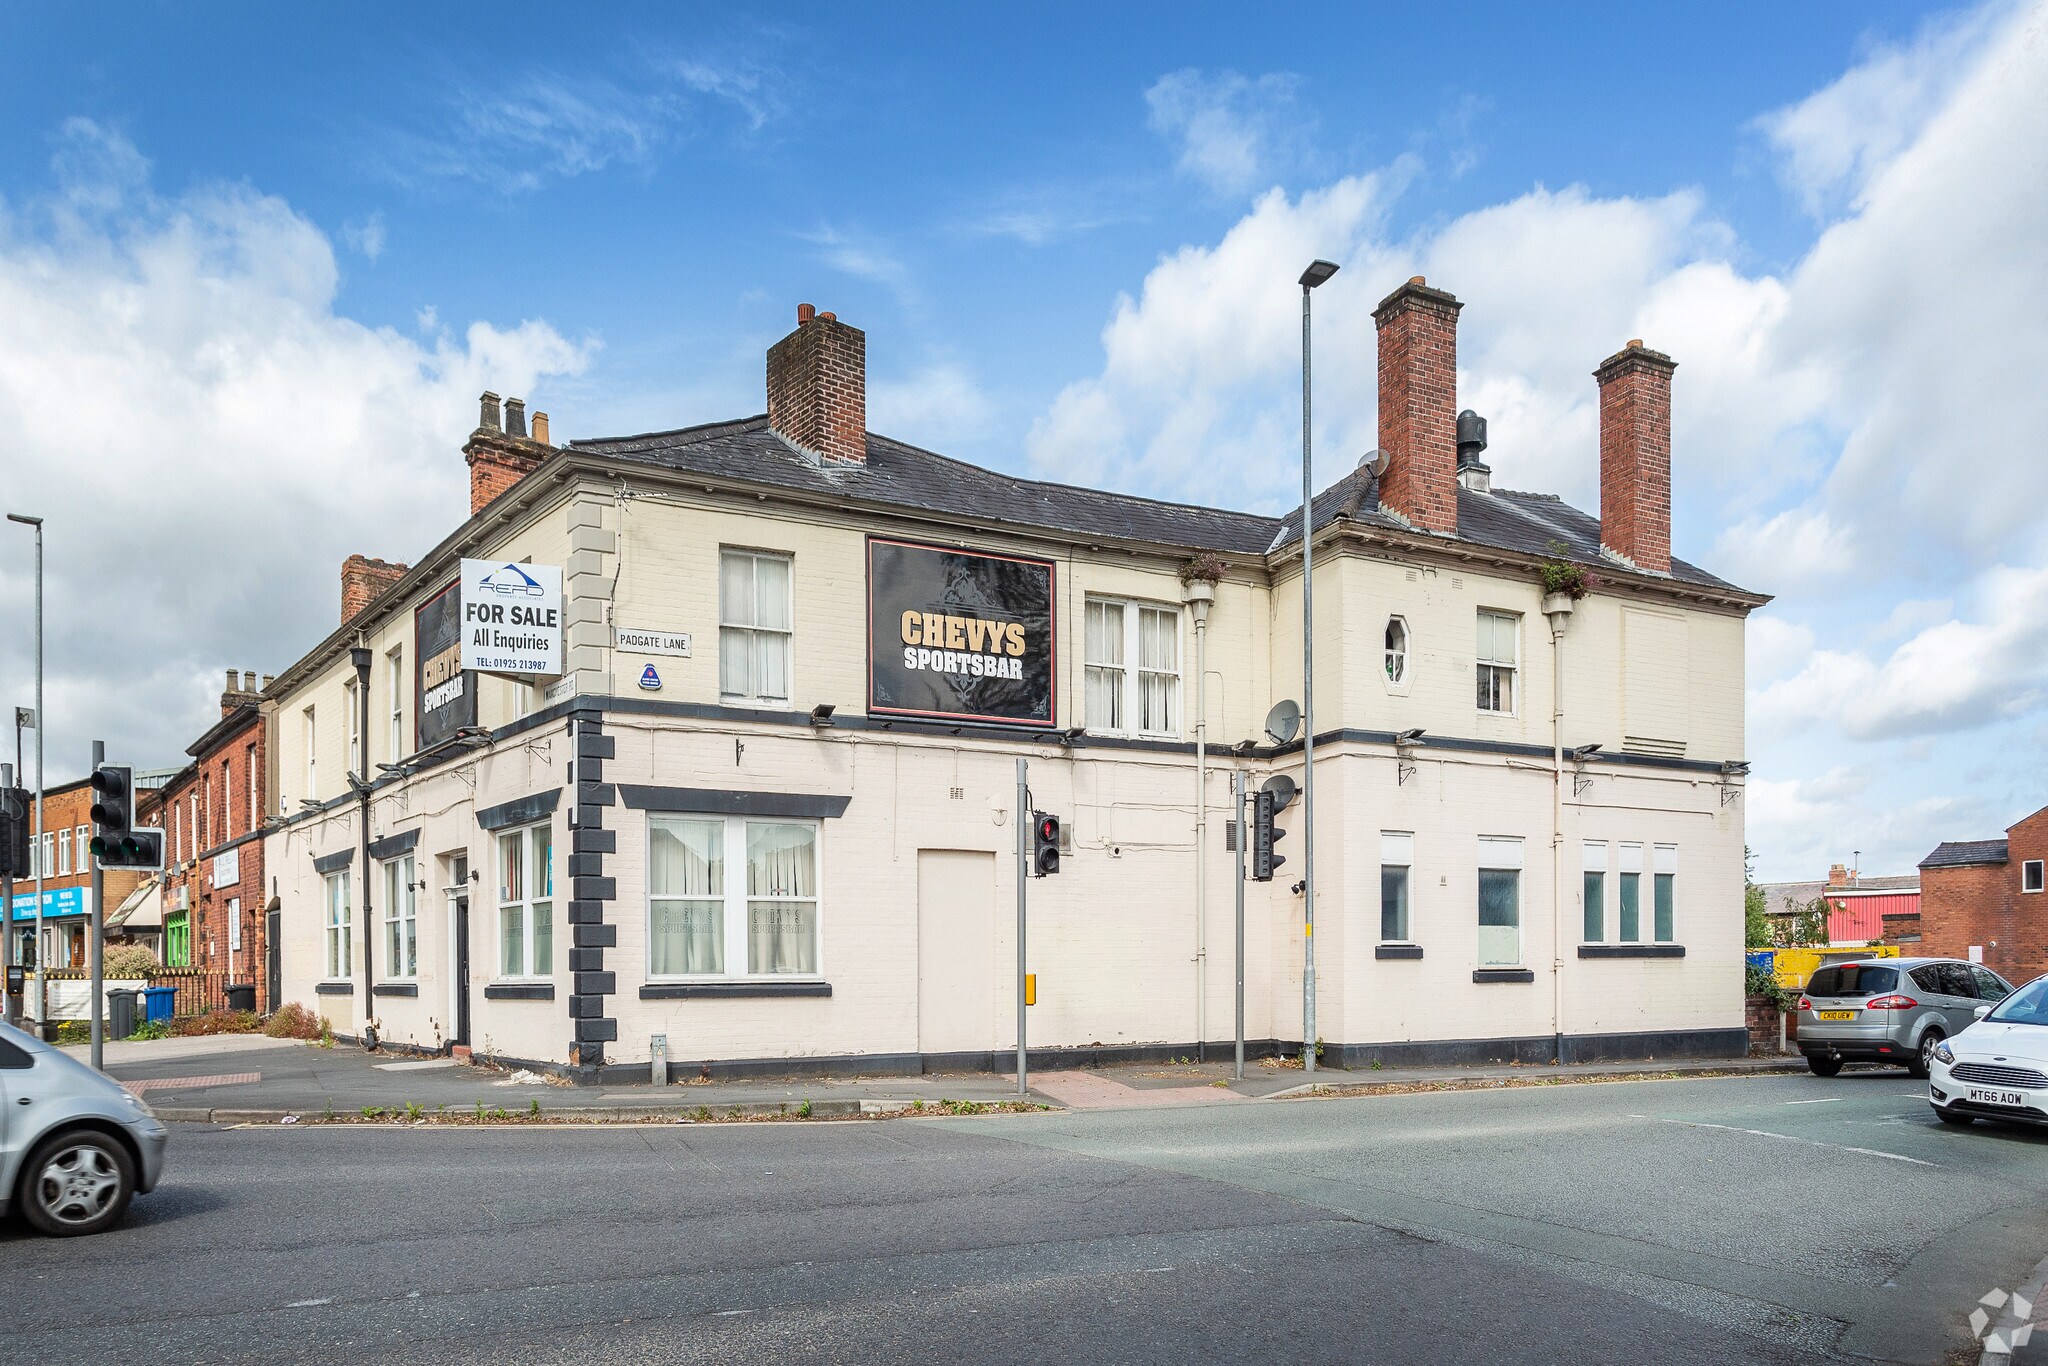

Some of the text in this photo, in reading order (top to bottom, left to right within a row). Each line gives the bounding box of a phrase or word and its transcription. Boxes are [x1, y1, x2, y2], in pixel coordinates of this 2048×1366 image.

[479, 581, 545, 597] READ
[466, 602, 557, 628] FOR SALE
[473, 628, 549, 653] All Enquiries
[900, 610, 1026, 656] CHEVYS
[620, 634, 686, 650] PADGATE LANE
[476, 657, 547, 670] TEL: 01925 213987
[903, 648, 1023, 680] SPORTSBAR
[424, 676, 464, 714] SPORTSBAR
[659, 907, 713, 924] CHEVYS
[752, 908, 804, 924] CHEVYS
[659, 924, 718, 934] SPORTSBAR
[752, 924, 806, 934] SPORTSBAR
[1970, 1089, 2022, 1105] MT66 AOW
